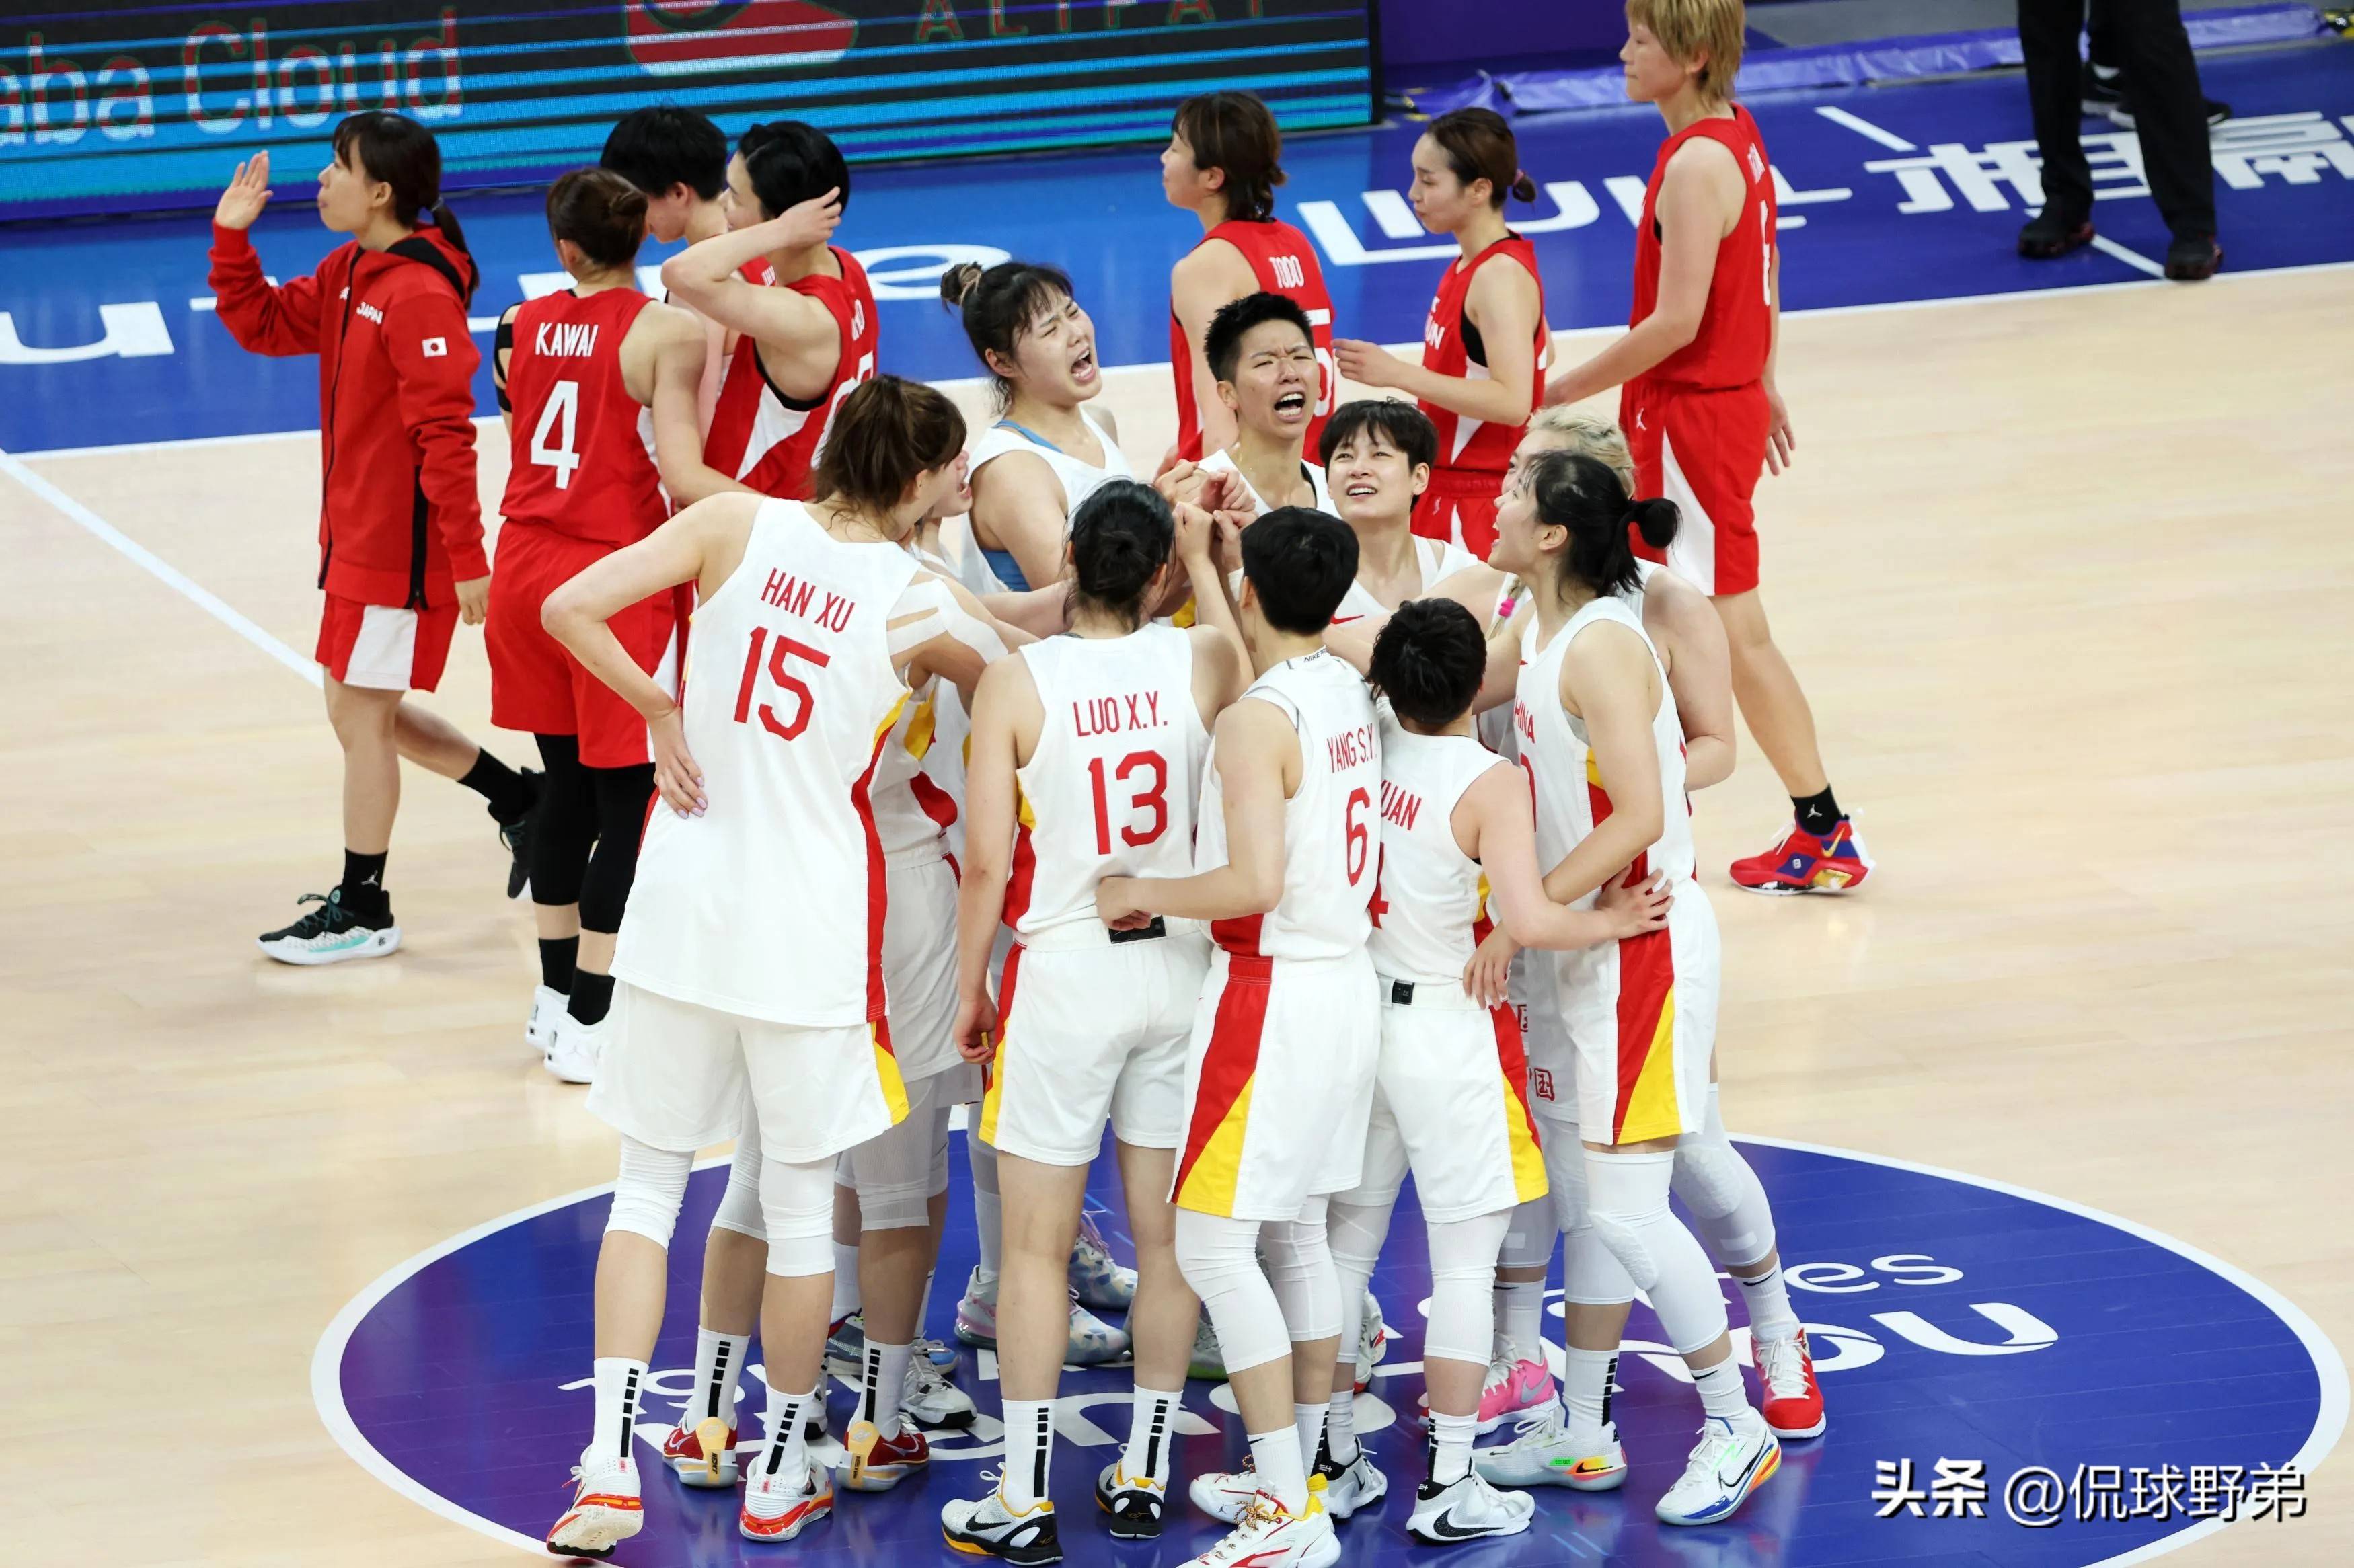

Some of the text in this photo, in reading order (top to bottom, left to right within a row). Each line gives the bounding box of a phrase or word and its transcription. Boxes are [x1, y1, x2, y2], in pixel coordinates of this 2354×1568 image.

[184, 7, 463, 133] Cloud
[1268, 254, 1304, 288] TODO
[356, 301, 383, 325] JAPAN
[535, 323, 598, 358] KAWAI
[530, 380, 579, 490] 4
[760, 567, 856, 634] HAN XU
[1303, 650, 1321, 662] NIKE
[734, 625, 831, 740] 15
[1073, 691, 1168, 737] LUO X.Y.
[1514, 695, 1535, 744] HINA
[1326, 731, 1357, 774] YANG
[1088, 750, 1168, 855] 13
[1381, 779, 1423, 831] UAN
[1346, 787, 1370, 888] 6
[1529, 1066, 1556, 1101] 国
